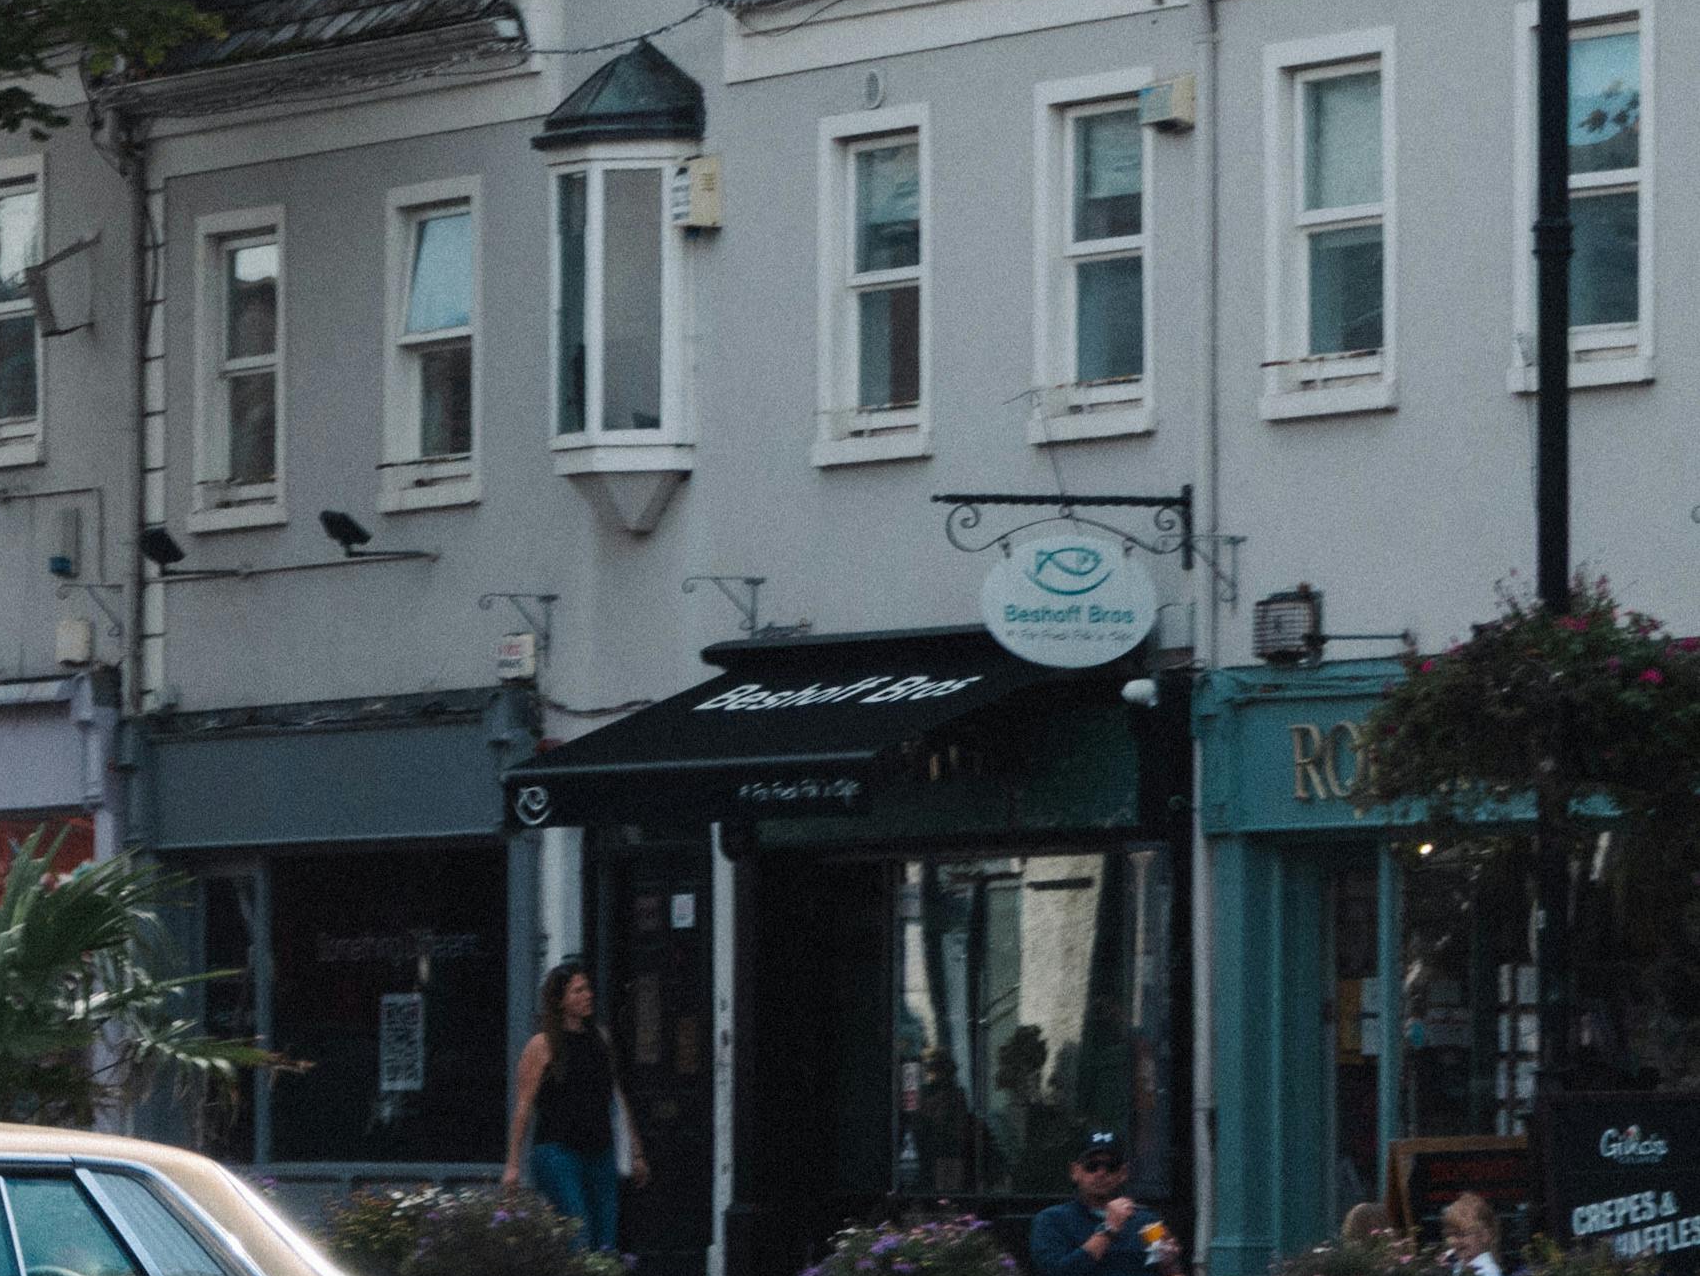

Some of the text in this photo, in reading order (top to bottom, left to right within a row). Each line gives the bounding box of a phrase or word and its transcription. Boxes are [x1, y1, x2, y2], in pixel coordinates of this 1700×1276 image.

[1004, 604, 1135, 625] Beshoff Bros
[692, 674, 984, 712] Beshoff Bros
[1572, 1190, 1679, 1236] CREPES &
